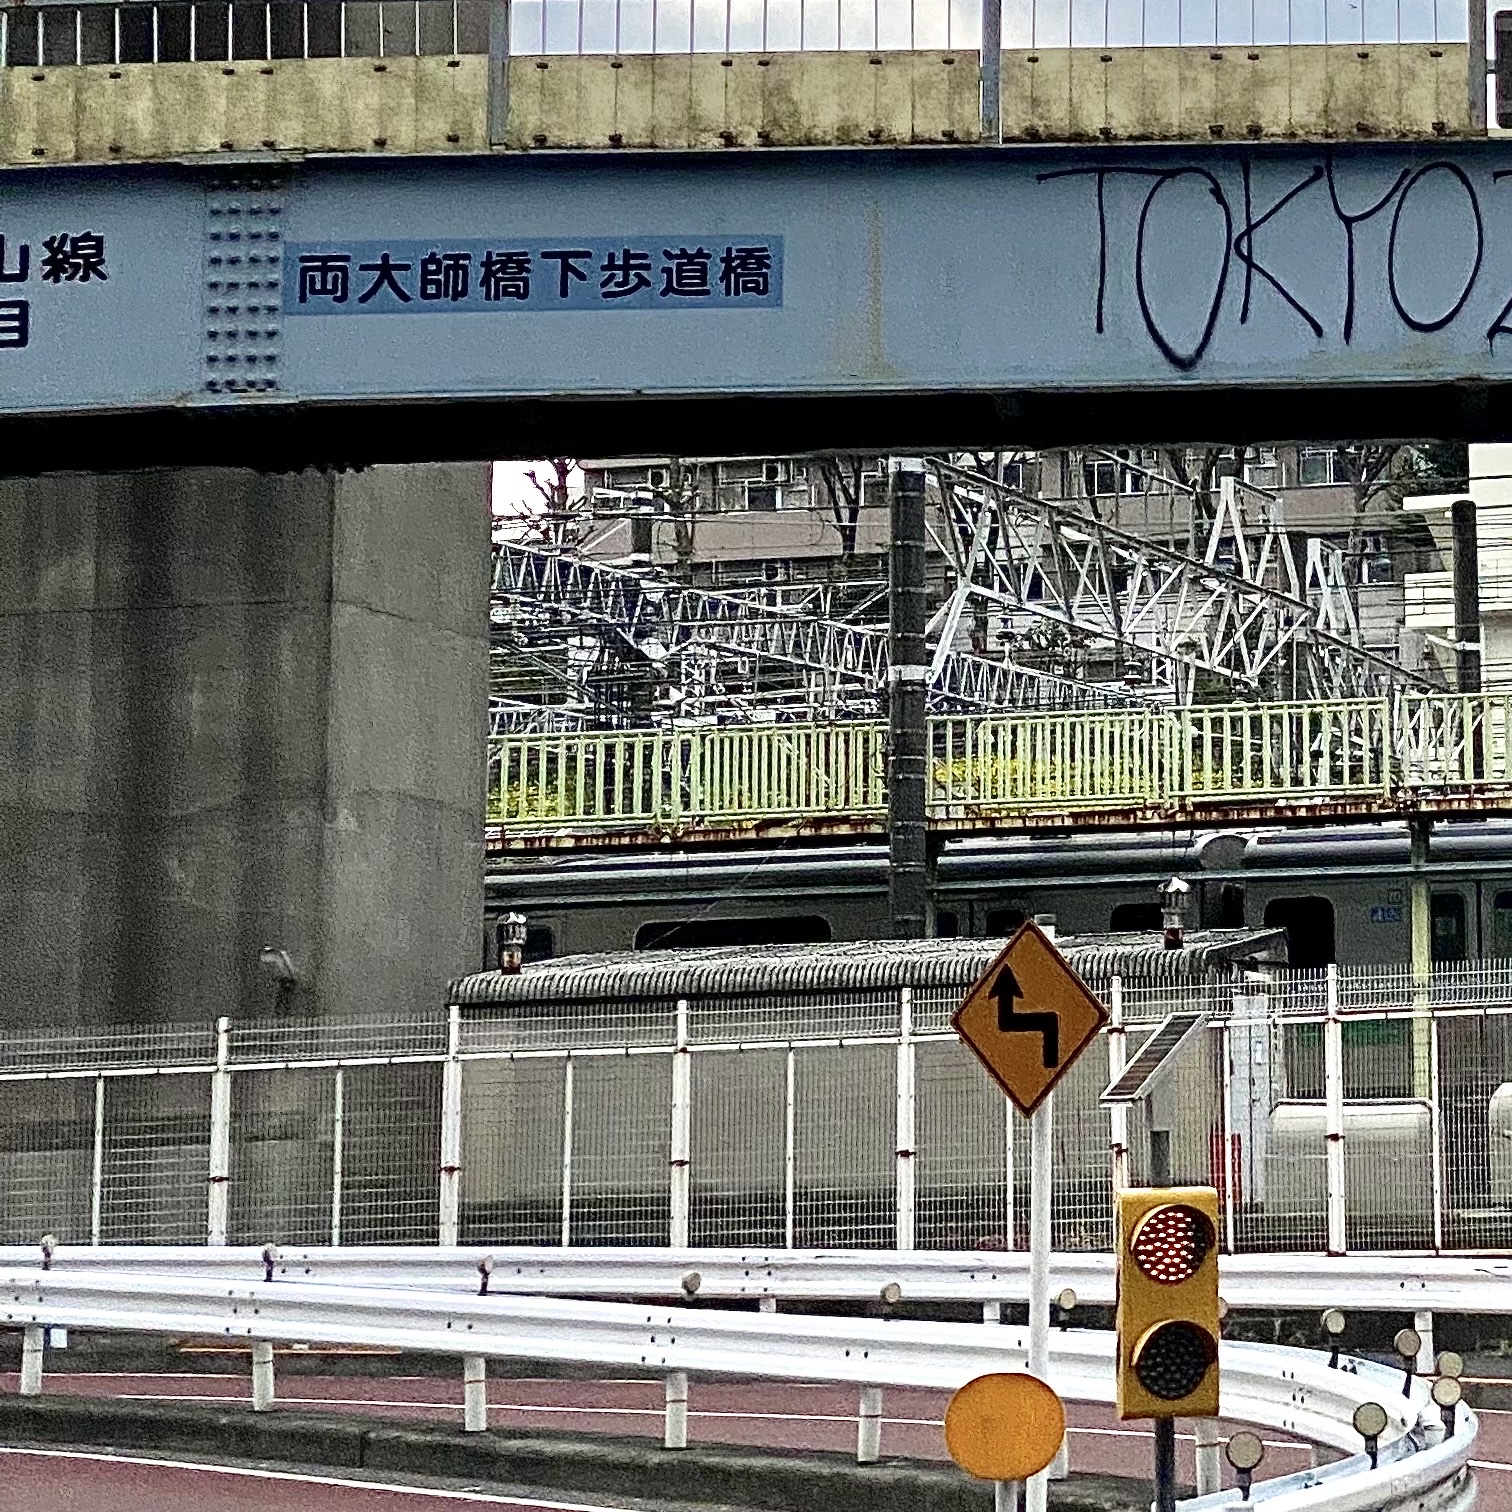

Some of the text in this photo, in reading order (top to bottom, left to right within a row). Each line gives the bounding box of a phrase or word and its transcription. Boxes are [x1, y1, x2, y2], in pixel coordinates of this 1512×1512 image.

[298, 245, 773, 305] 両大師橋下歩道橋
